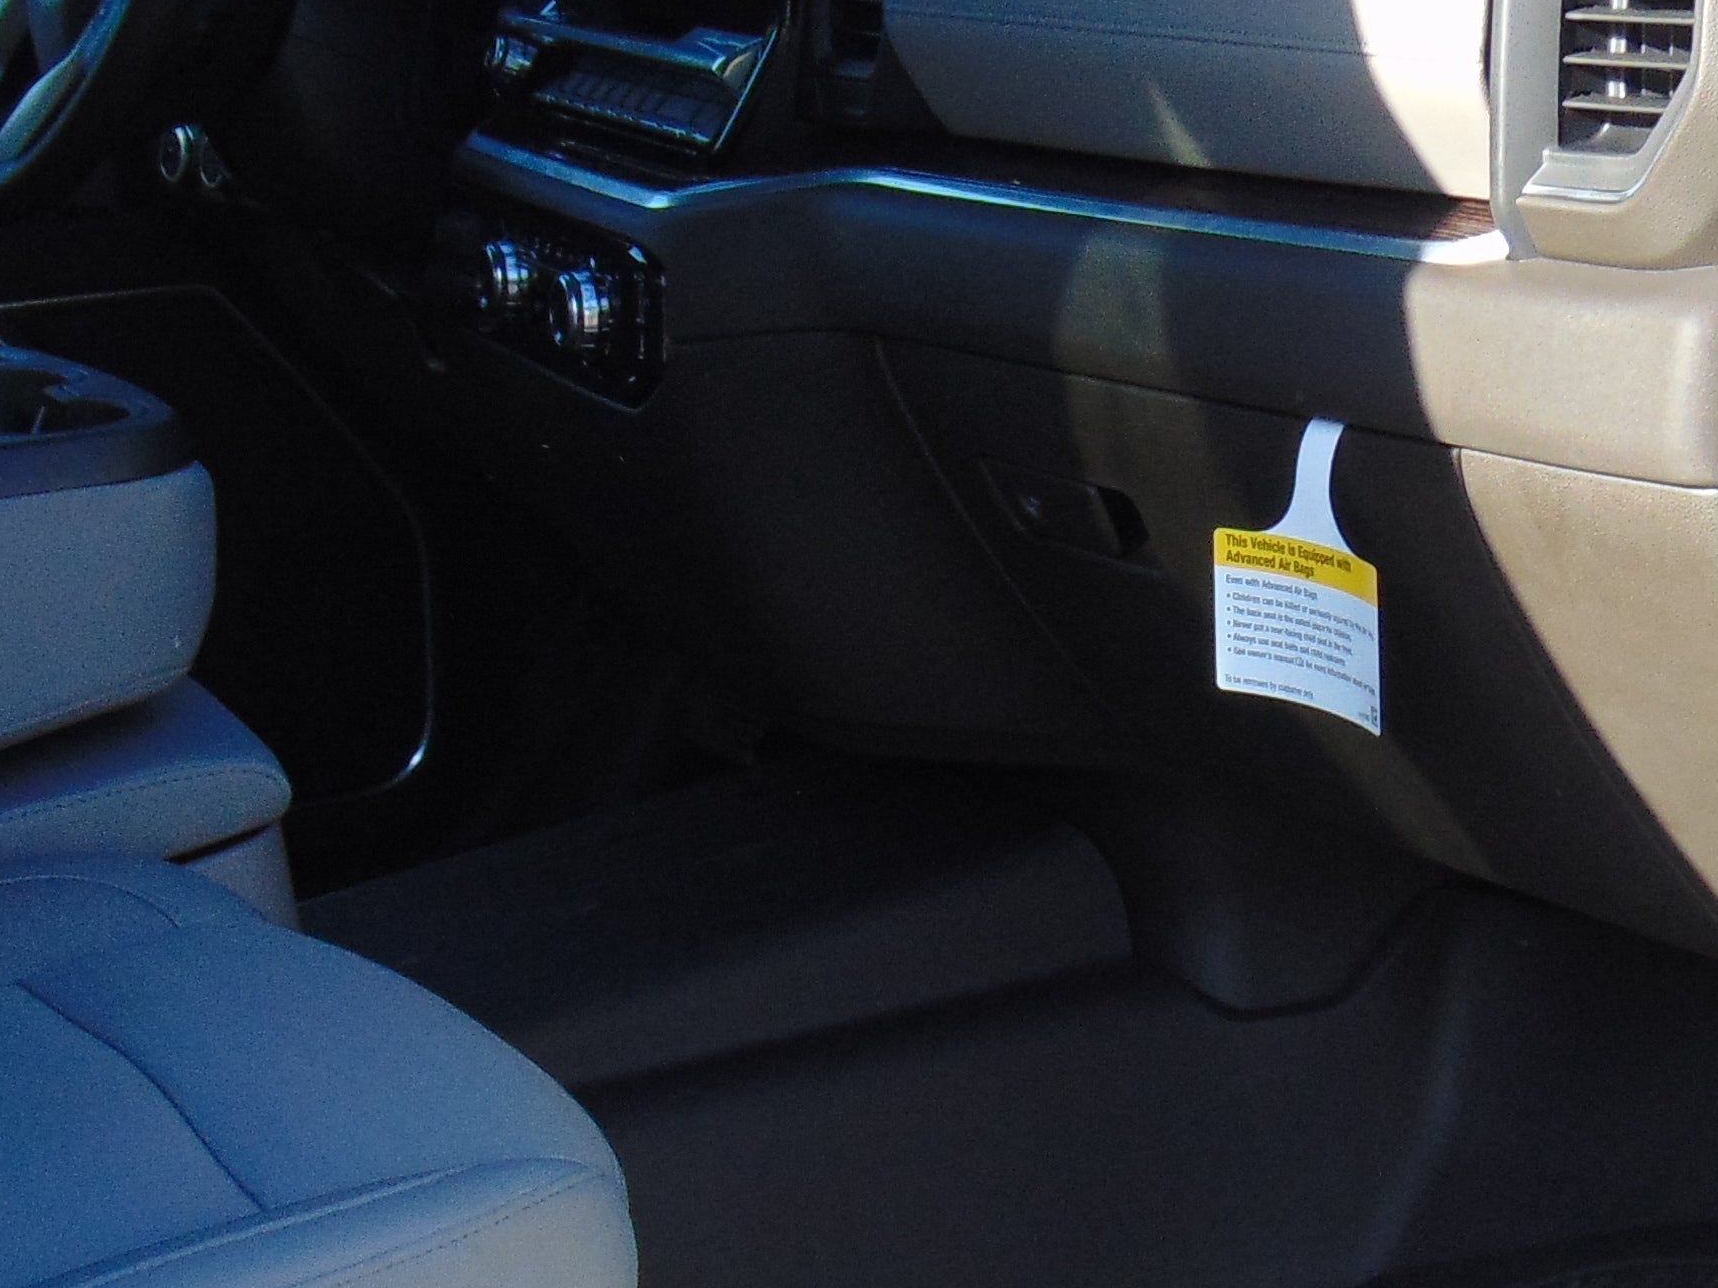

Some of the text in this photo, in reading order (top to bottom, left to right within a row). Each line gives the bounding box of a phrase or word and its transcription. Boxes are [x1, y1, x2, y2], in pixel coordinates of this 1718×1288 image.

[1225, 533, 1352, 573] This Vehicle is Equipped with
[1226, 549, 1314, 579] Advanced Air Bags
